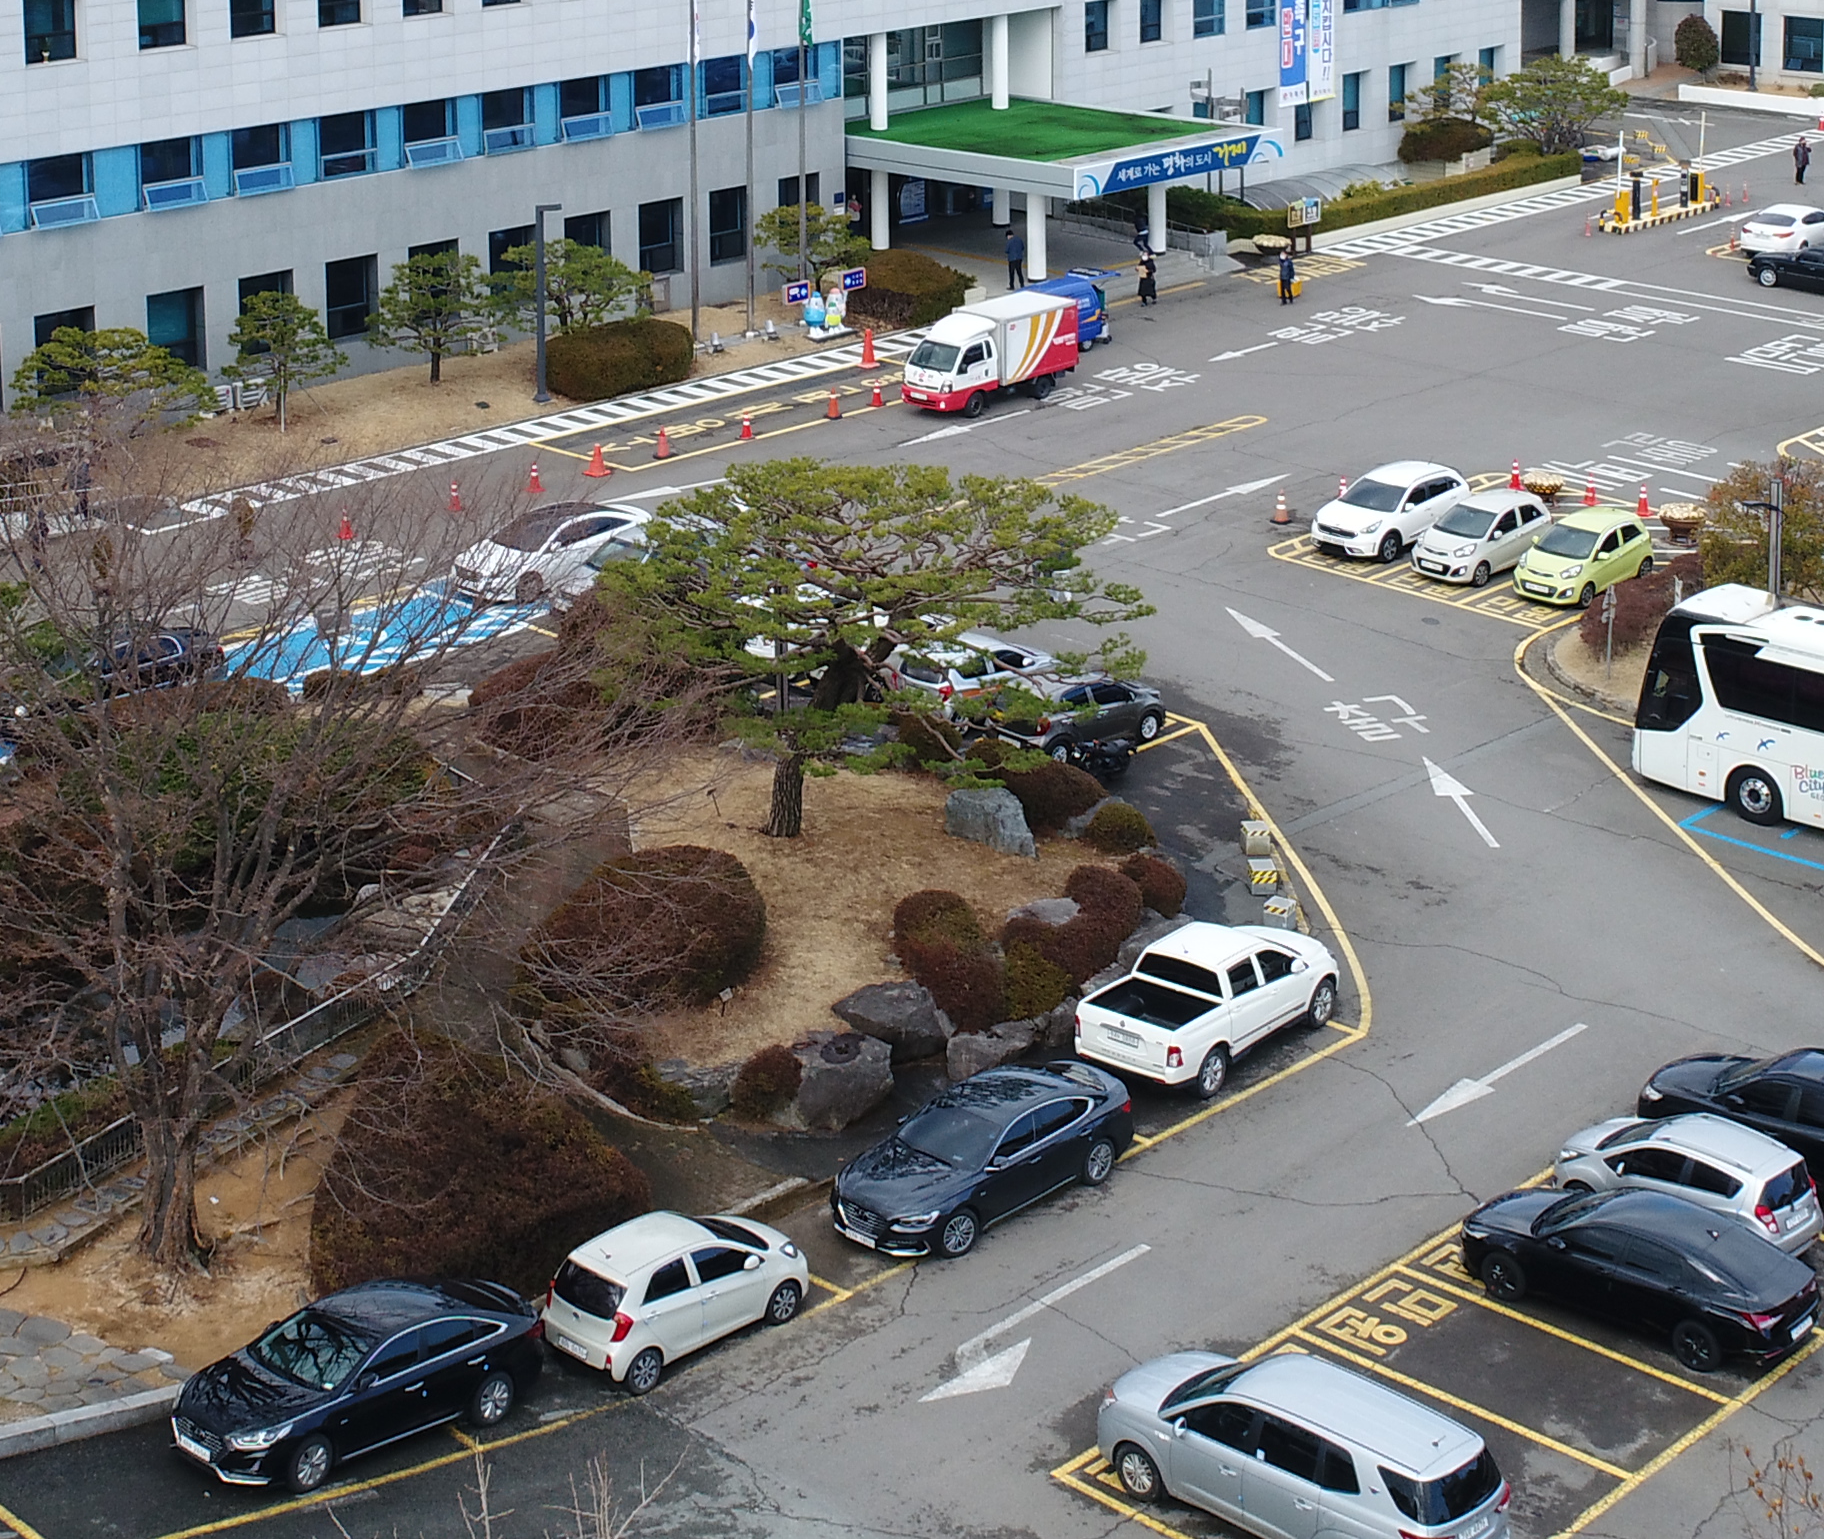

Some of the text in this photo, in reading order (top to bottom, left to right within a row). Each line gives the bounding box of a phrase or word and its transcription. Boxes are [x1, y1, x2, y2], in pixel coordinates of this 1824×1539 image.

[1116, 141, 1247, 182] 세계로 가는 평화의 도시 거제
[1323, 694, 1431, 742] 출구
